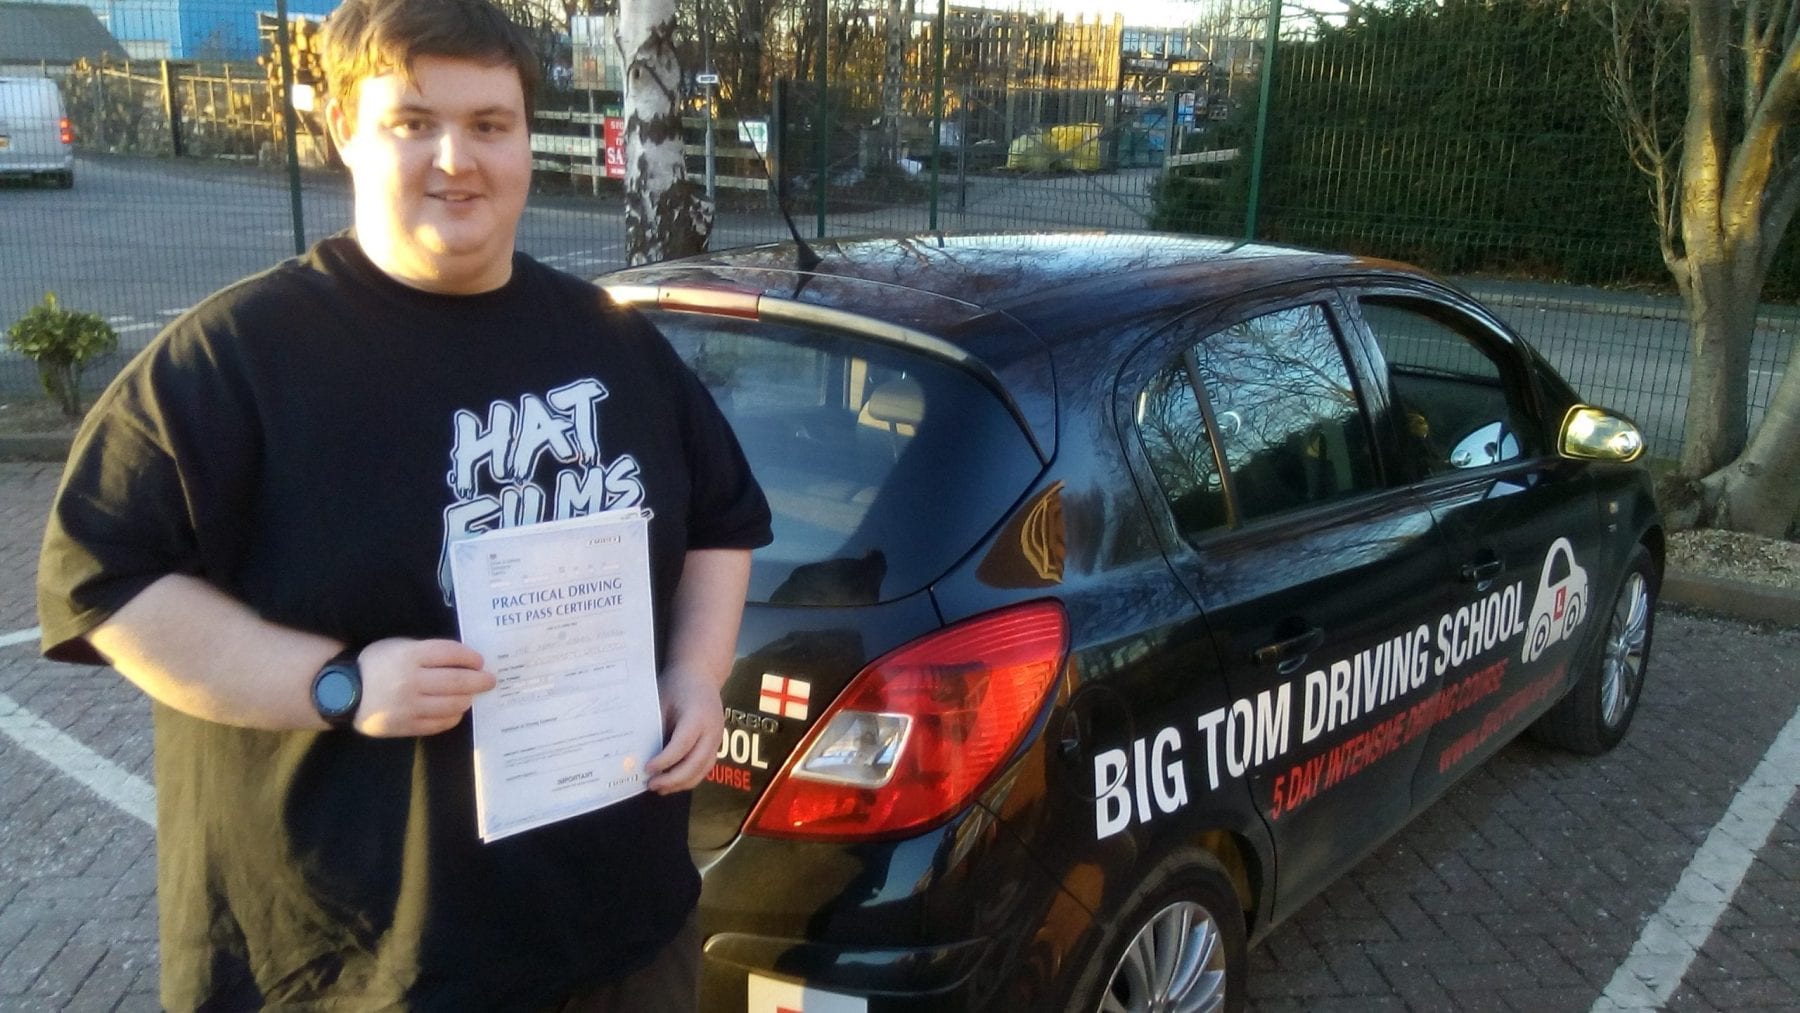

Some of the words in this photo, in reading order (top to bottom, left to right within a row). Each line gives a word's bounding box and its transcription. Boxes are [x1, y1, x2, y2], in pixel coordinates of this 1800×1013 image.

[447, 378, 609, 501] HAT
[491, 587, 565, 610] PRACTICAL
[568, 577, 623, 598] DRIVING
[494, 611, 521, 627] TEST
[526, 606, 553, 622] PASS
[556, 594, 623, 616] CERTIFICATE
[1094, 726, 1188, 840] BIG
[1198, 682, 1291, 792] TOM
[1302, 624, 1430, 745] DRIVING
[1434, 580, 1525, 676] SCHOOL
[1271, 775, 1285, 821] 5
[1286, 754, 1326, 811] DAY
[1325, 711, 1408, 790] INTENSIVE
